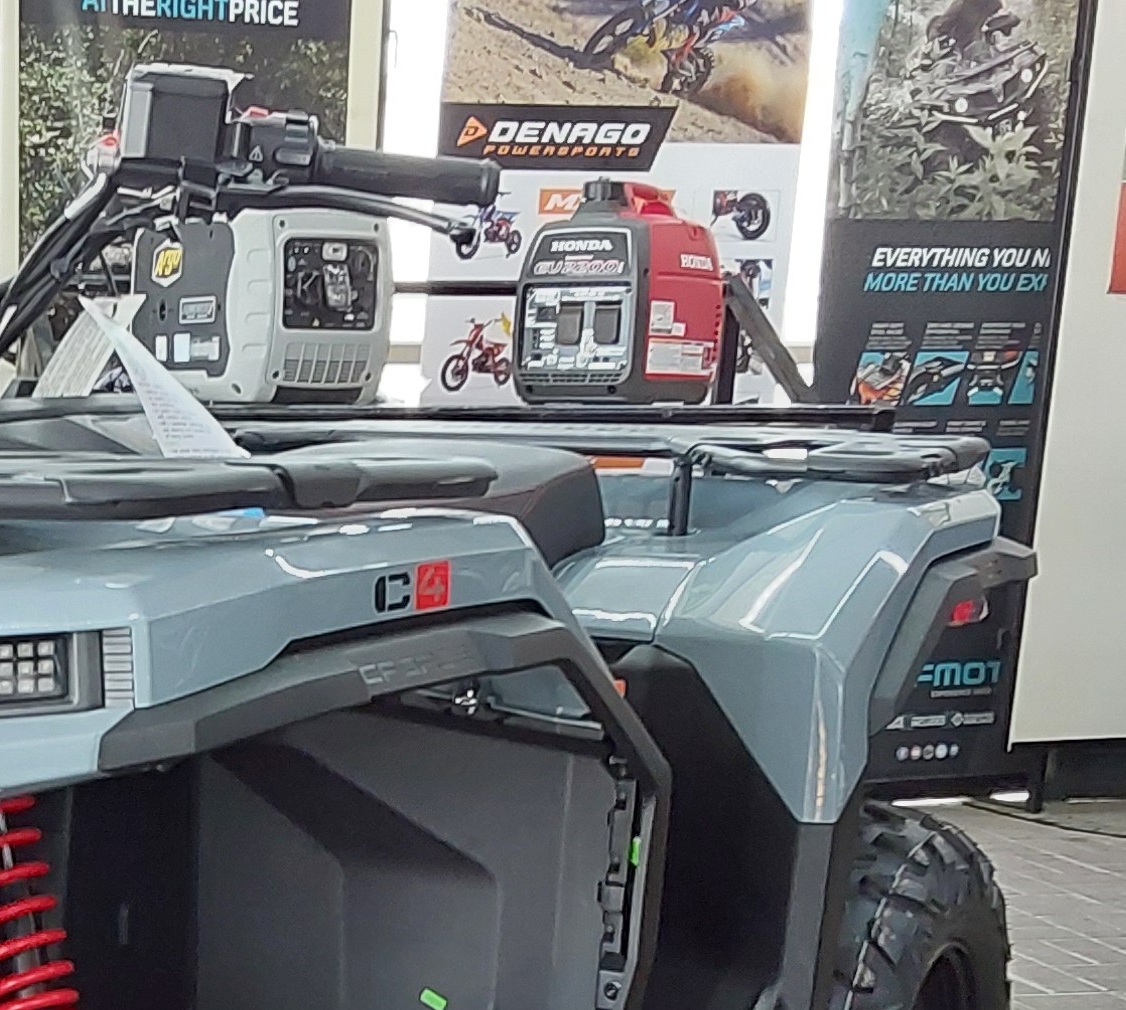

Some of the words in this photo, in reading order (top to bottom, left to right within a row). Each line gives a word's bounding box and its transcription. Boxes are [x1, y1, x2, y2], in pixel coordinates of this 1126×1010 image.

[487, 120, 651, 145] DENAGO
[482, 144, 641, 158] POWERSPORTS
[550, 239, 613, 252] HONDA
[871, 246, 990, 268] EVERYTHING
[992, 246, 1032, 268] YOU
[863, 272, 923, 292] MORE
[923, 272, 974, 292] THAN
[977, 272, 1016, 292] YOU
